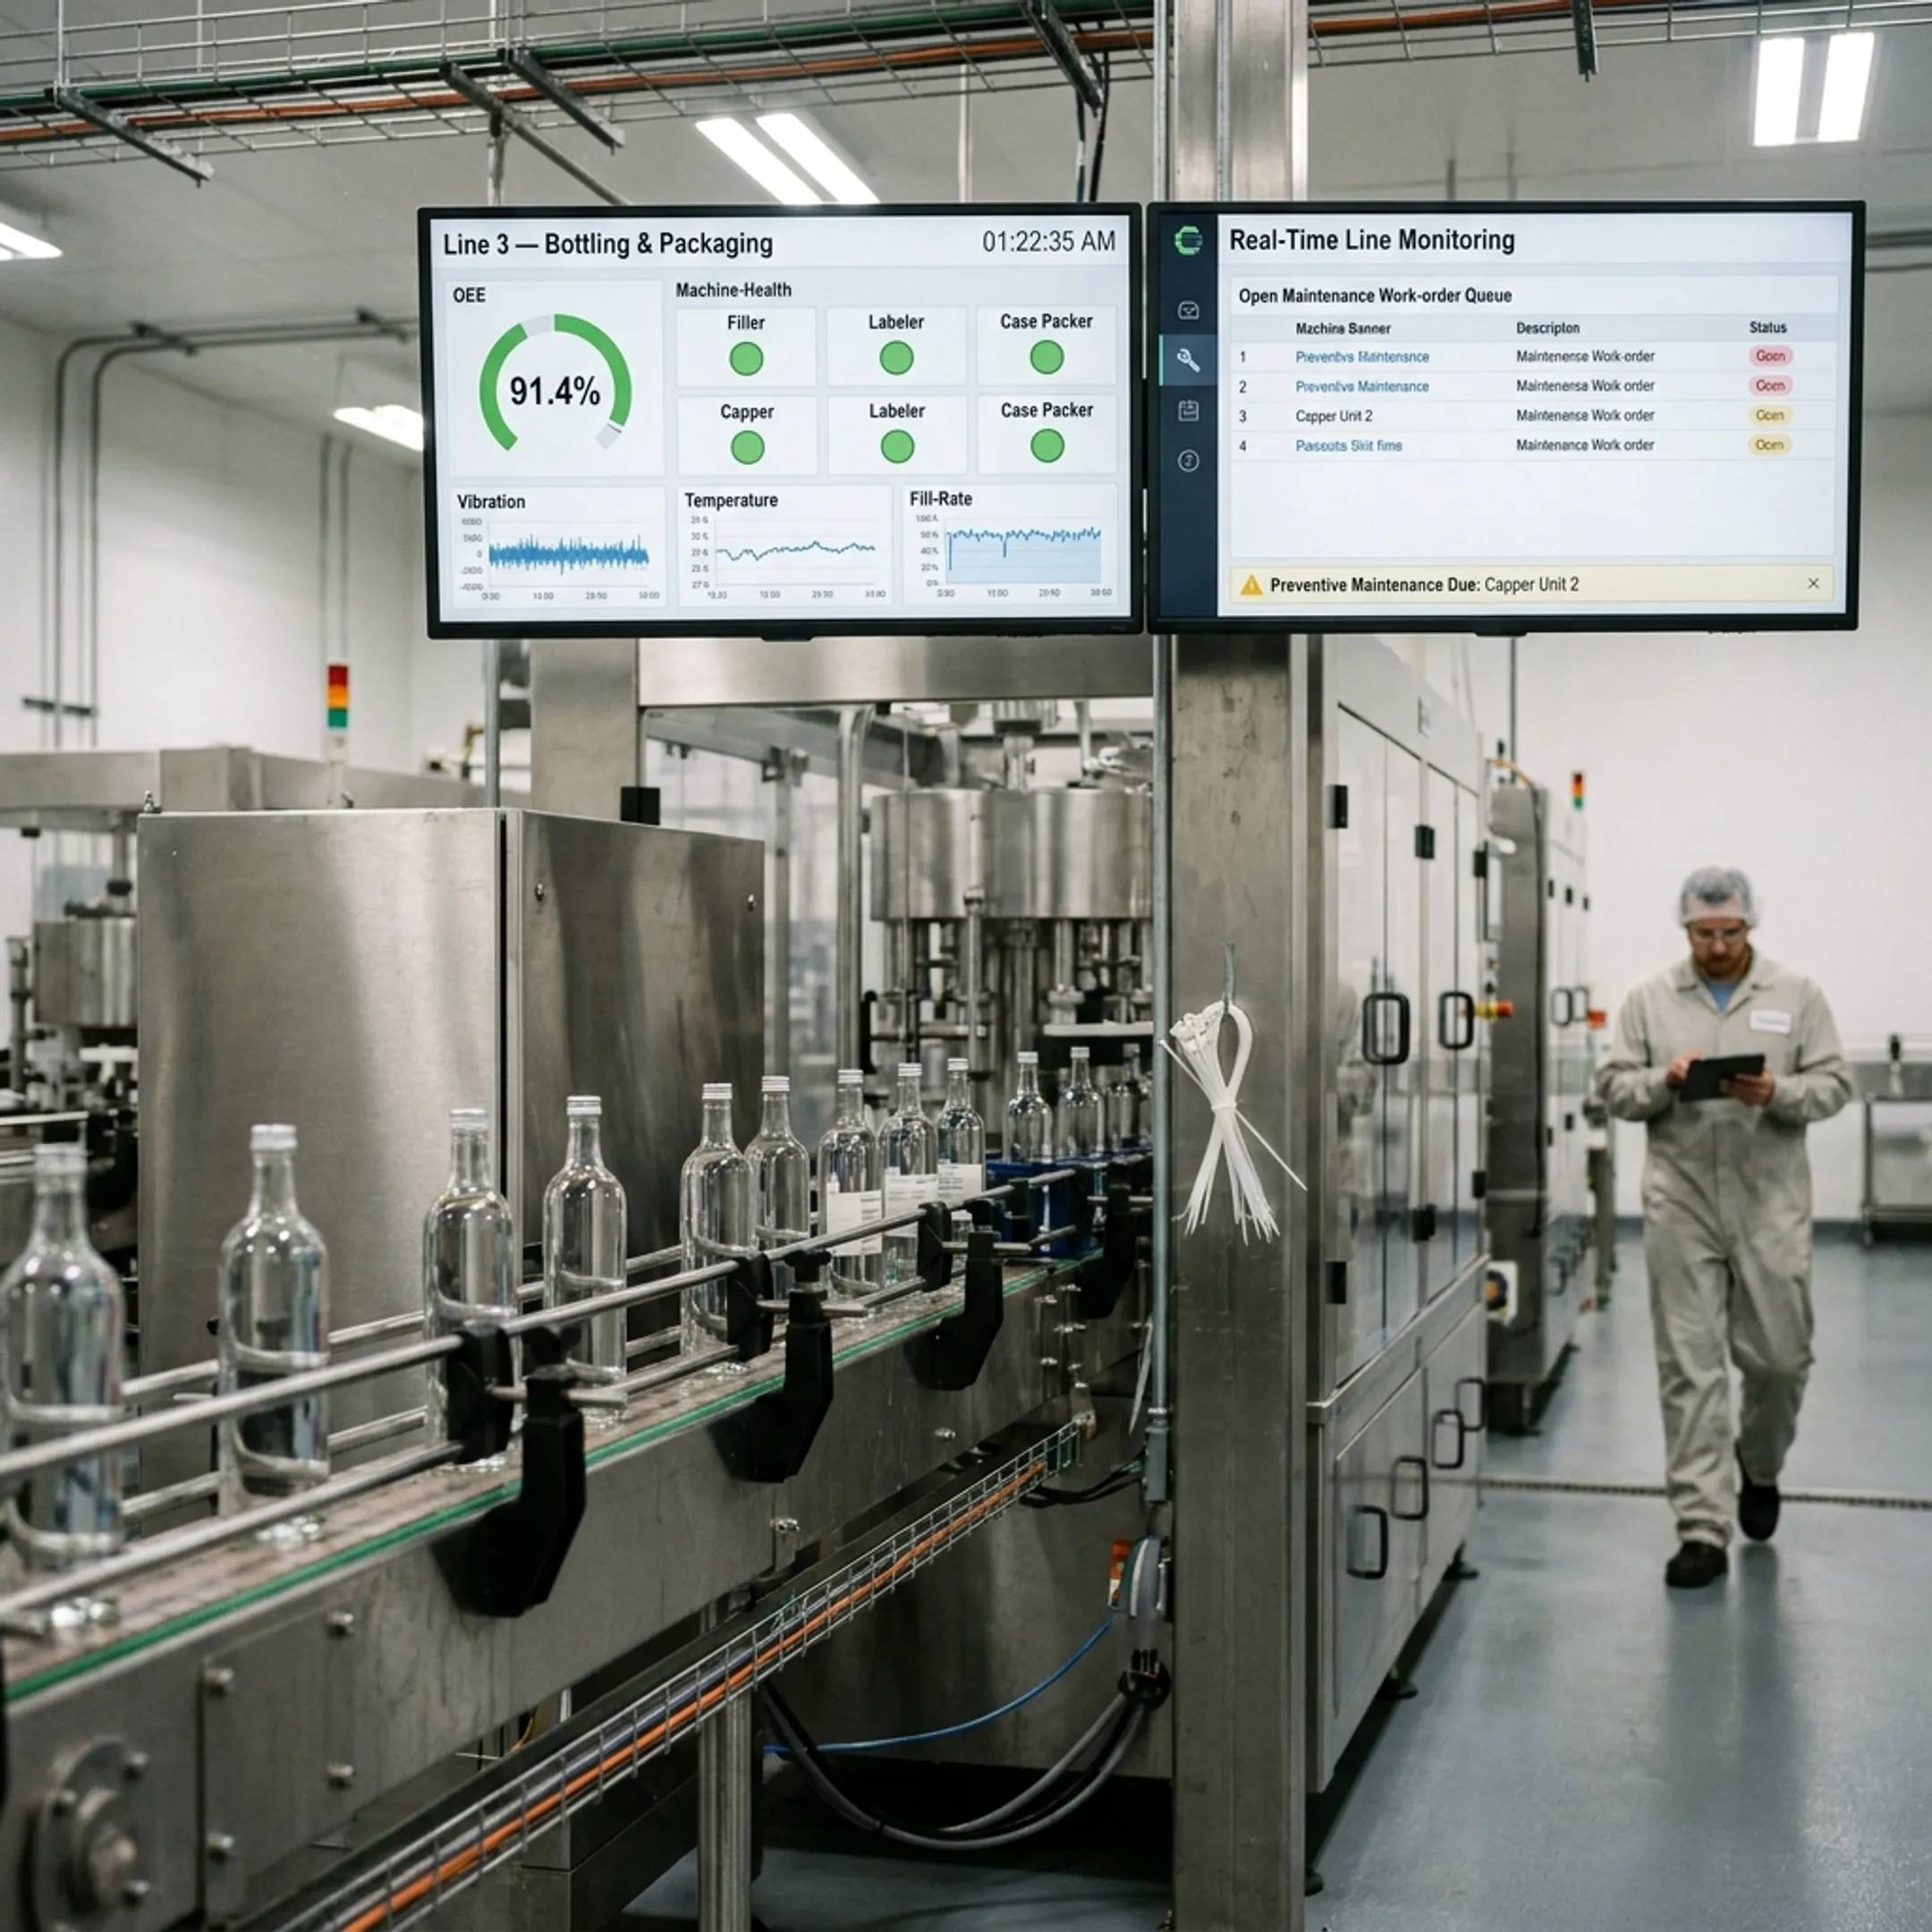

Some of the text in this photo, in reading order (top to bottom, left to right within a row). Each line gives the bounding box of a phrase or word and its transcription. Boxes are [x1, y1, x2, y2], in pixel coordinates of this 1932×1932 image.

[445, 233, 489, 255] Line
[497, 233, 508, 254] 3
[546, 233, 629, 259] Bottling
[638, 233, 652, 253] &
[660, 233, 772, 258] Packaging
[983, 230, 1115, 251] 01:22:35 AM
[1231, 228, 1514, 255] Real-Time Line Monitoring
[453, 287, 486, 302] OEE
[676, 282, 792, 297] Machine-Health
[1240, 287, 1512, 306] Open Maintenance Work-order Queue
[728, 315, 765, 330] Filler
[869, 314, 924, 329] Labeler
[1001, 313, 1093, 329] Case Packer
[1241, 352, 1245, 362] 1
[511, 376, 600, 405] 91.4%
[1240, 380, 1246, 393] 2
[1623, 379, 1655, 392] order
[721, 404, 775, 422] Capper
[870, 403, 925, 418] Labeler
[1002, 402, 1093, 418] Case Packer
[1240, 410, 1246, 422] 3
[1340, 411, 1361, 421] Unit
[1365, 410, 1373, 421] 2
[1624, 410, 1655, 421] order
[1240, 440, 1246, 452] 4
[1623, 439, 1655, 451] order
[457, 495, 525, 509] Vibration
[685, 493, 778, 511] Temperature
[911, 491, 972, 506] Fill-Rate
[1271, 576, 1579, 595] Preventive Maintenance Due: Capper Unit 2
